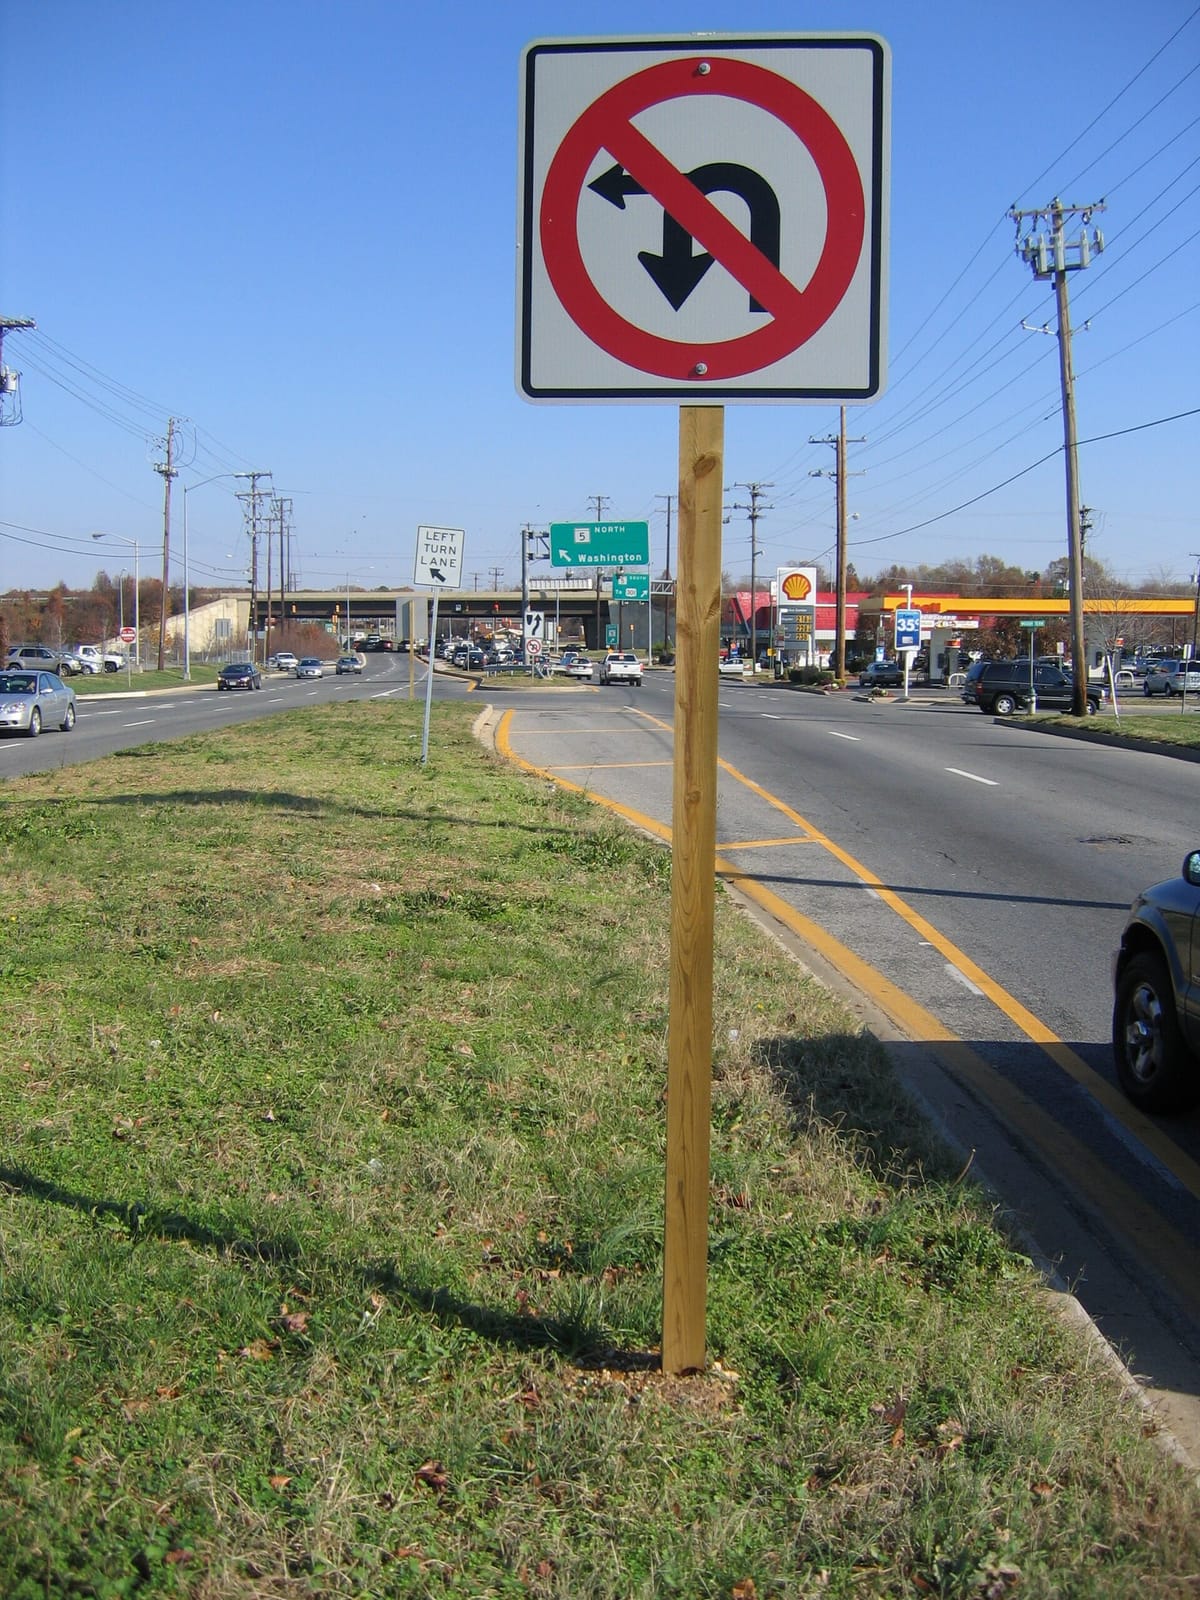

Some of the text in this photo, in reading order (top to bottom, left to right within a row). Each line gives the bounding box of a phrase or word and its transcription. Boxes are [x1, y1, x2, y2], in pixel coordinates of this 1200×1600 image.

[594, 526, 625, 534] NORTH
[426, 531, 456, 542] LEFT
[579, 532, 586, 541] 5
[424, 544, 457, 555] TURN
[421, 556, 457, 568] LANE
[578, 553, 642, 563] Washington
